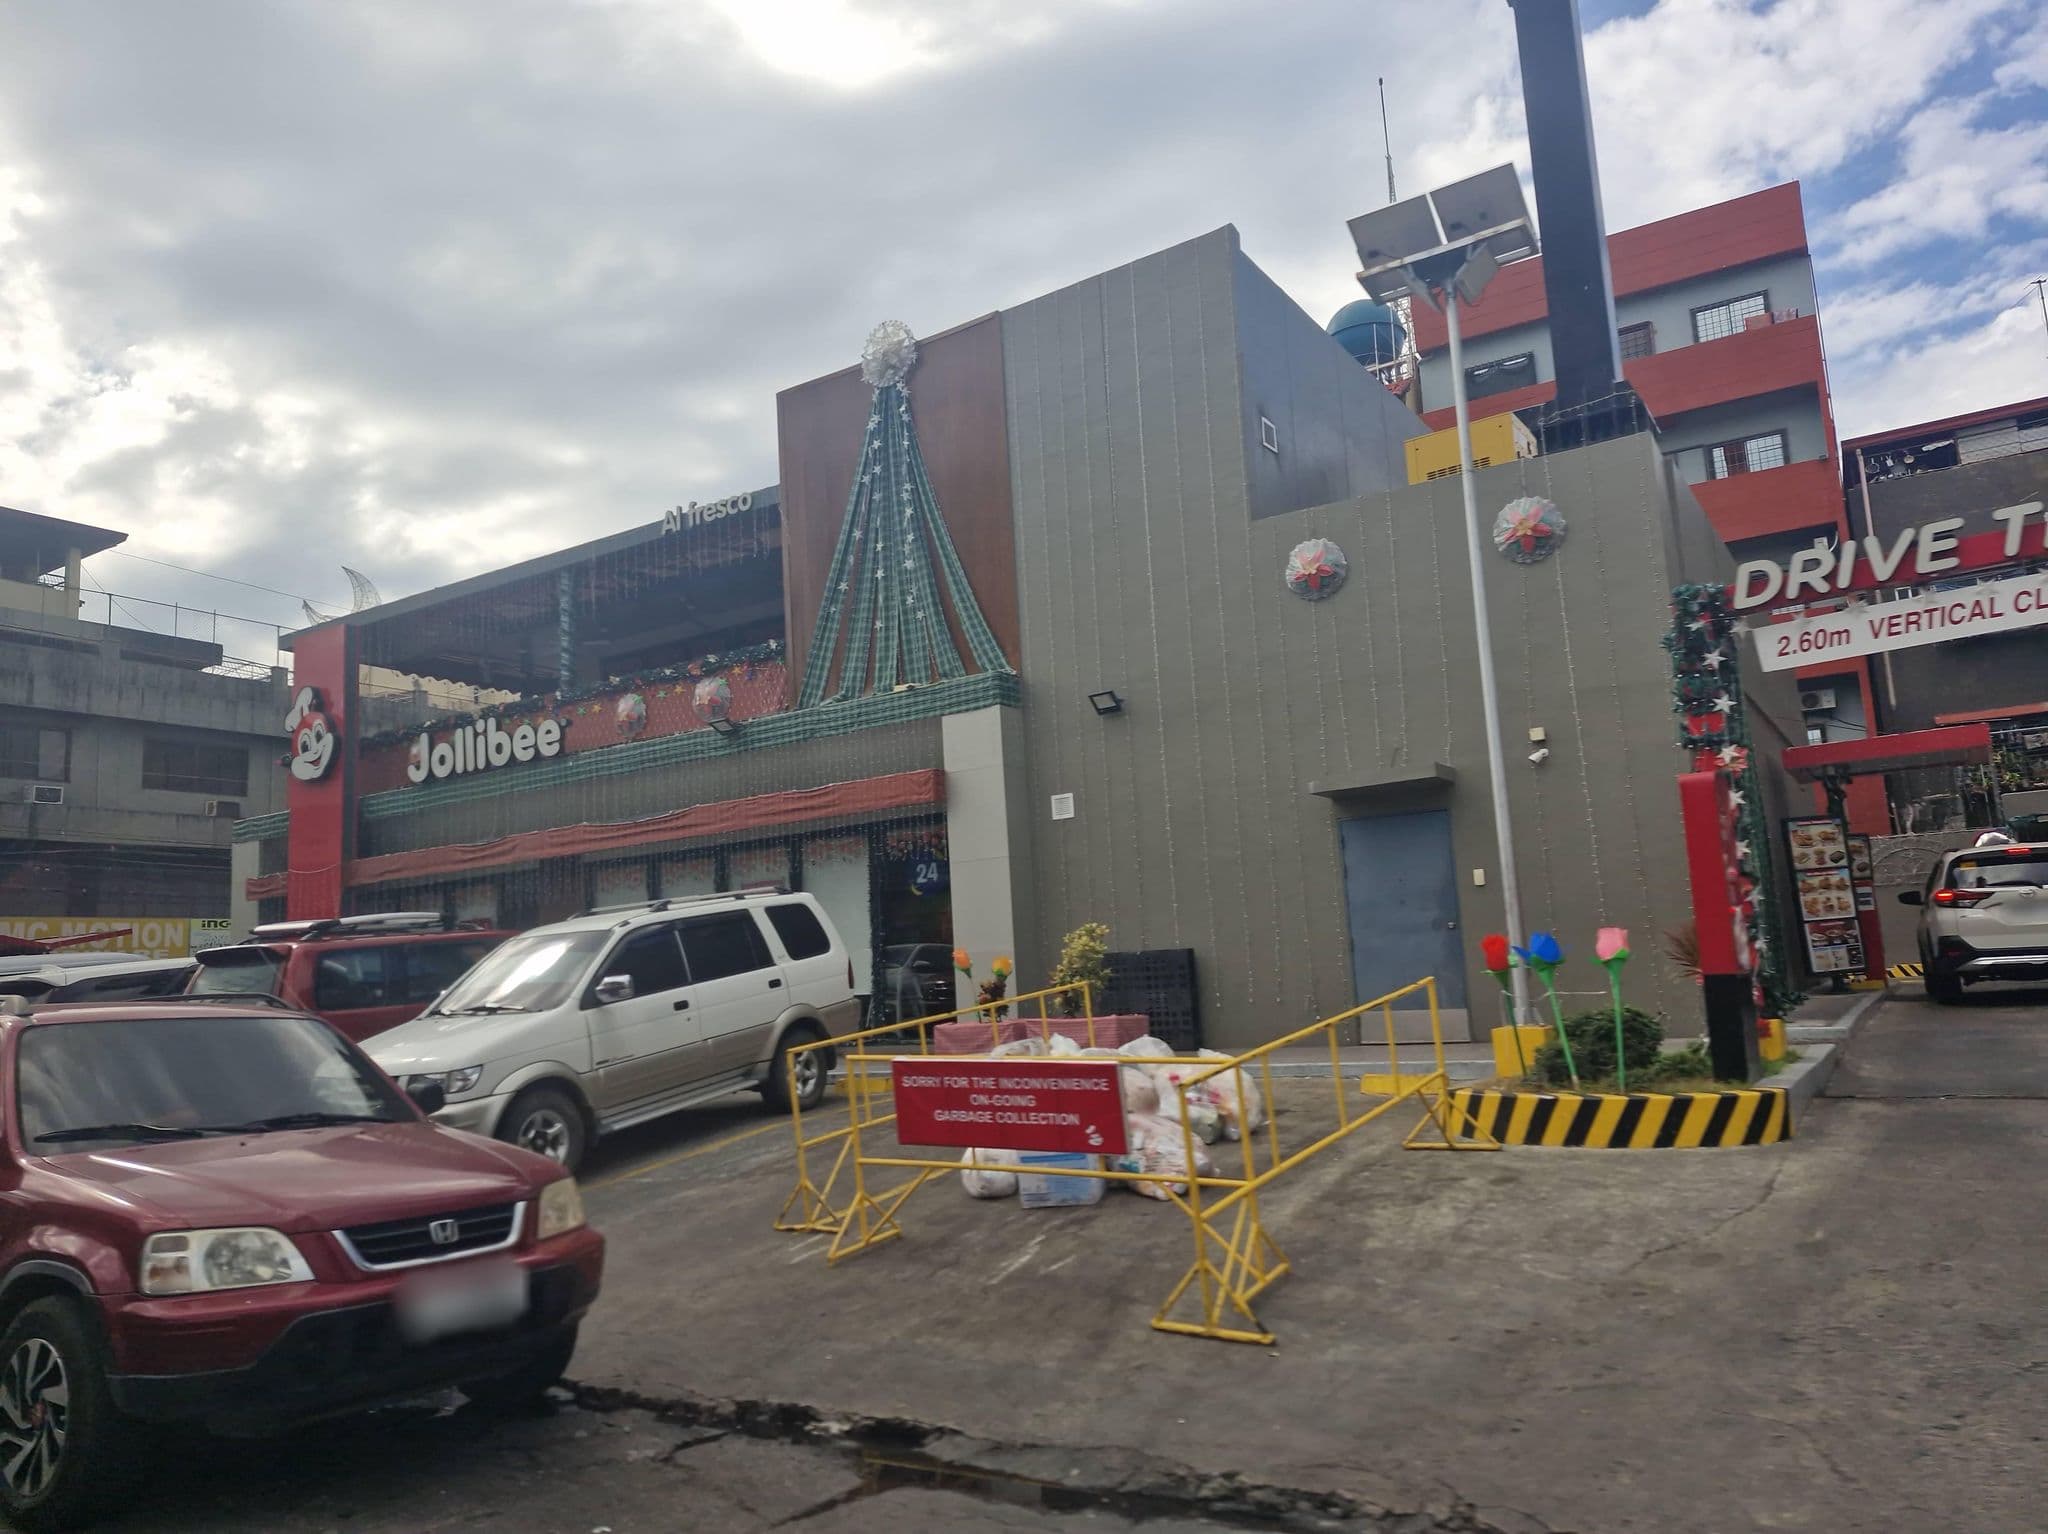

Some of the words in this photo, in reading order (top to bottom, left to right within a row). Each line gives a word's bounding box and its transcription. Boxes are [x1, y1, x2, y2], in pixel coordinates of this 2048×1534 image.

[661, 505, 682, 535] Al
[687, 492, 752, 528] fresco
[1733, 517, 1965, 610] DRIVE
[1992, 500, 2048, 557] T
[1776, 628, 1850, 657] 2.60m
[1869, 596, 2004, 640] VERTICAL
[407, 717, 561, 783] Jollibee
[916, 862, 938, 883] 24
[902, 1076, 941, 1088] SORRY
[943, 1076, 970, 1089] FOR
[970, 1077, 997, 1089] THE
[998, 1077, 1110, 1091] INCONVENIENCE
[969, 1094, 1037, 1107] ON-GOING
[934, 1110, 993, 1123] GARBAGE
[995, 1112, 1080, 1125] COLLECTION
